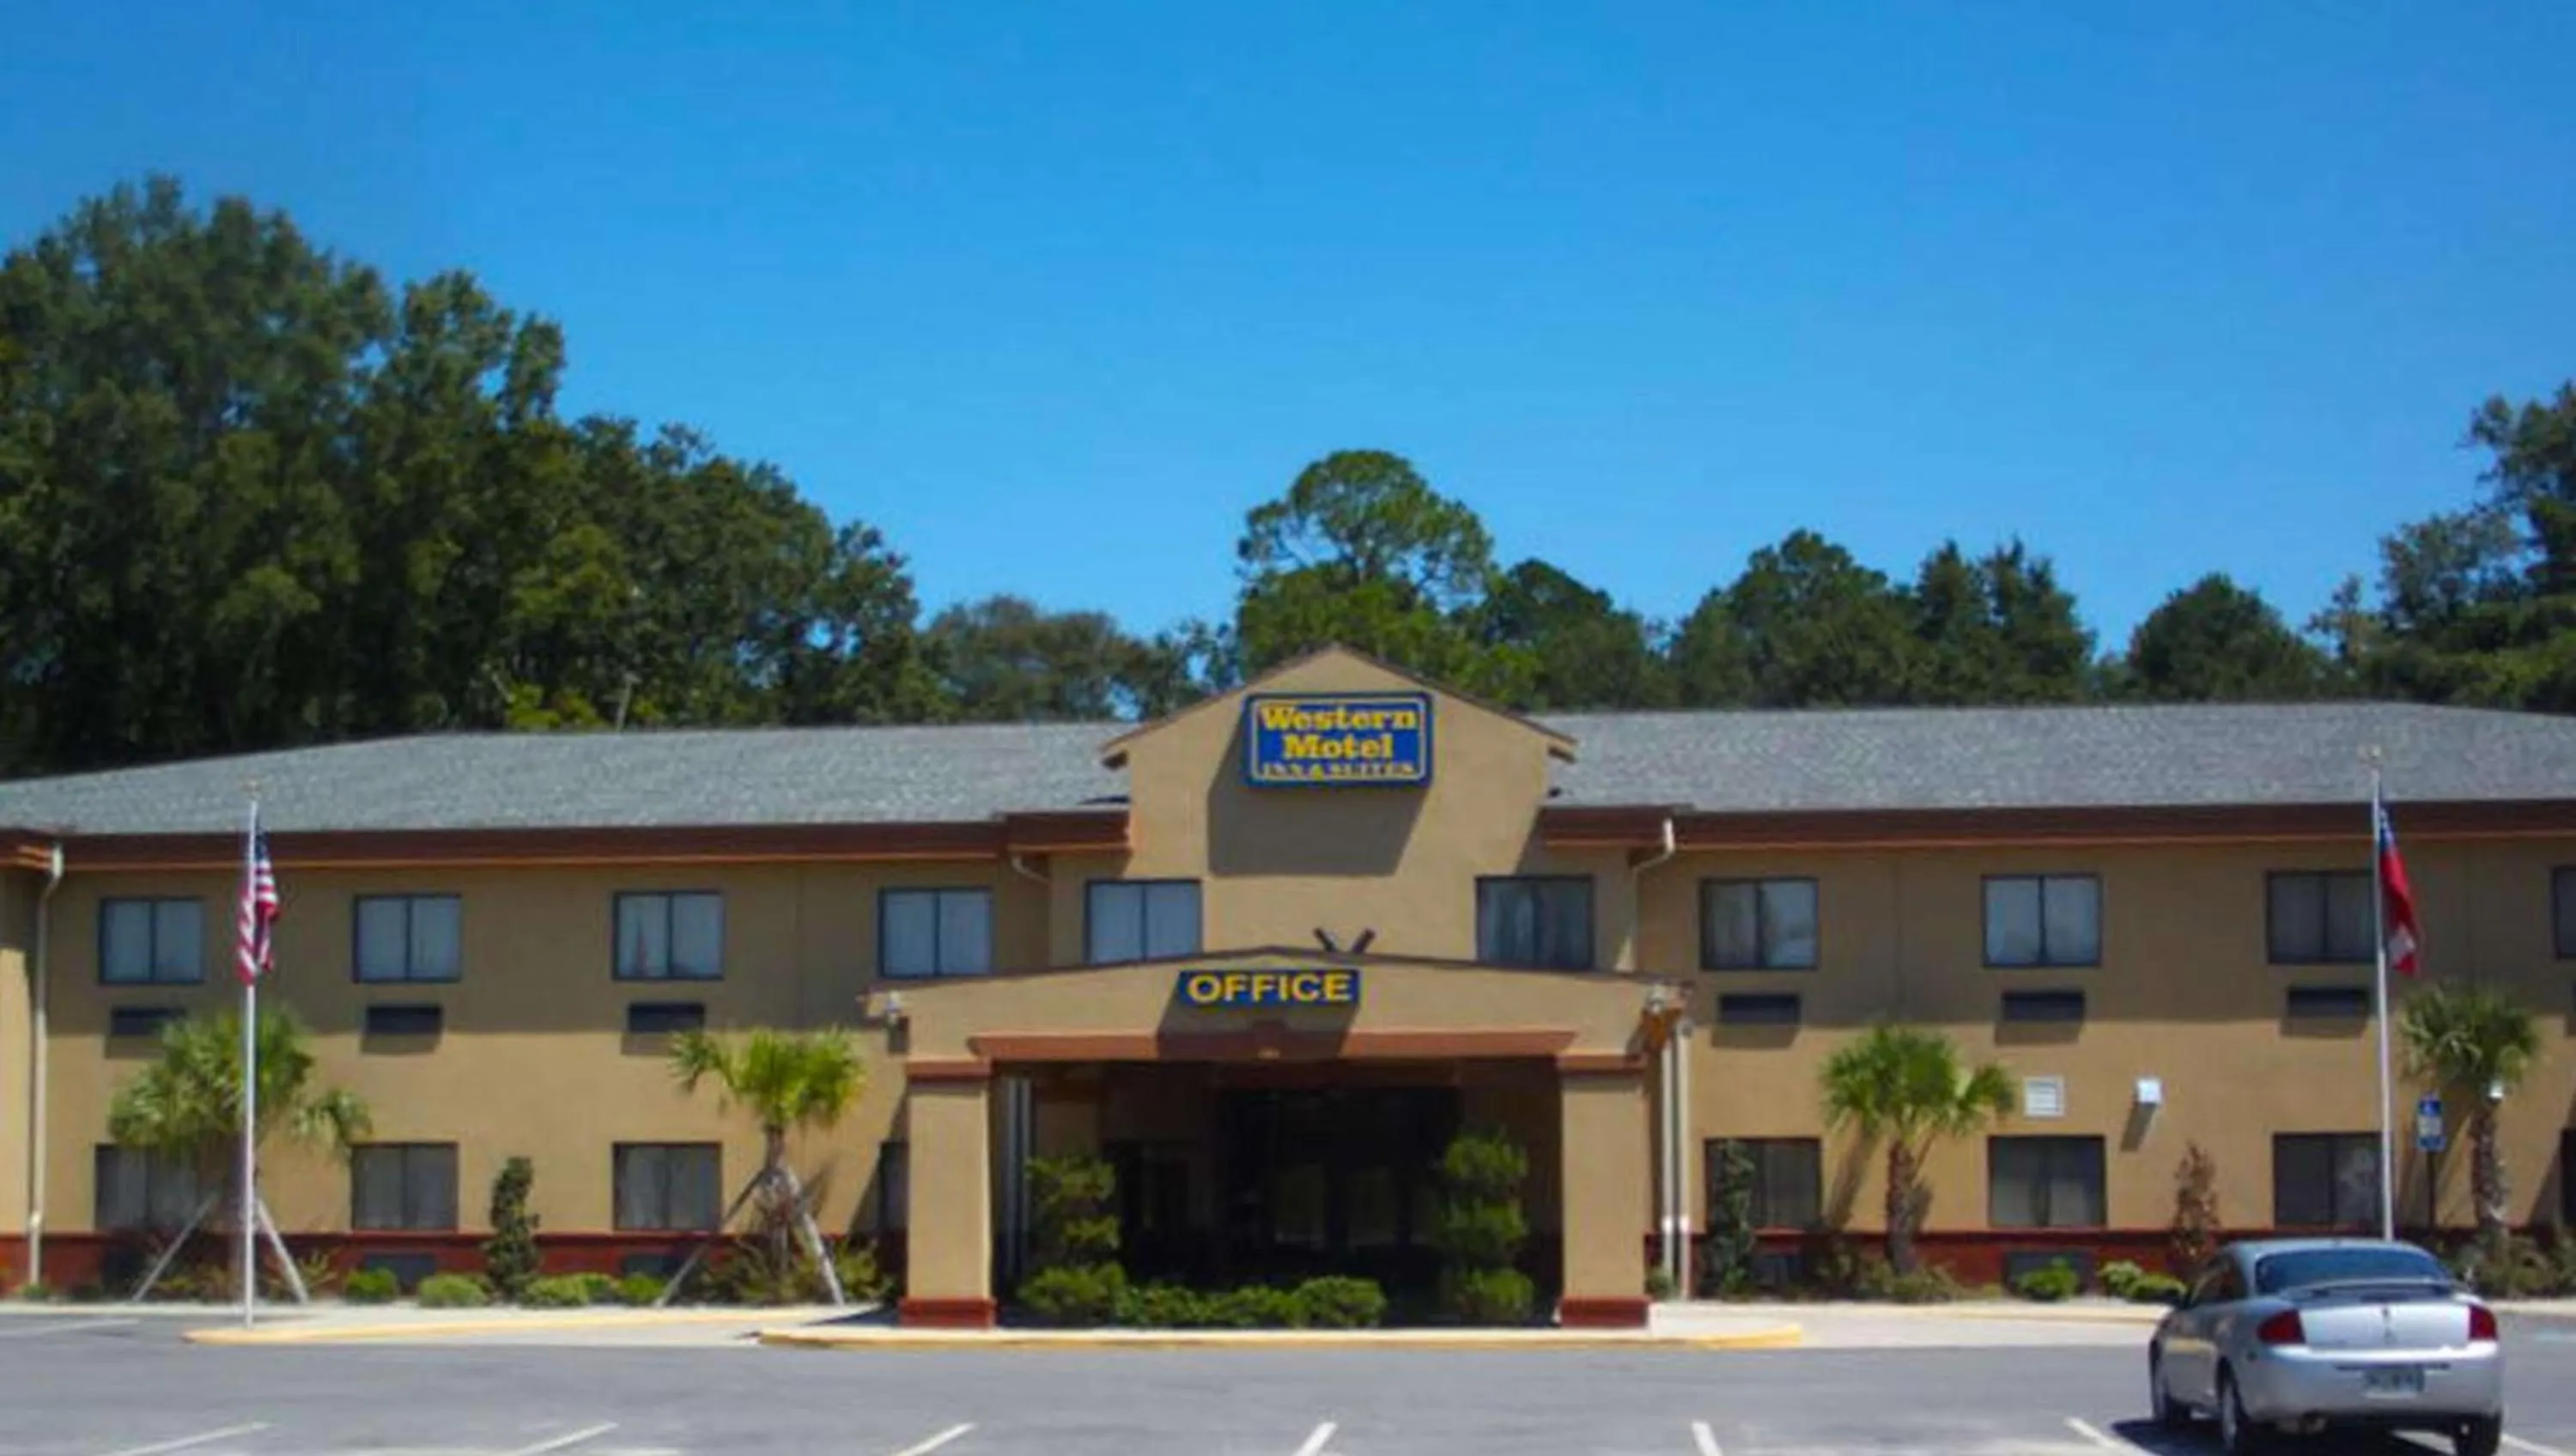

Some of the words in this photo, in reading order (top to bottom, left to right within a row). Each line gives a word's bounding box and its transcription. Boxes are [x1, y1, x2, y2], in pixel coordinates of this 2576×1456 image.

[1261, 705, 1417, 731] Western
[1283, 733, 1394, 760] Motel
[1187, 972, 1353, 1003] OFFICE
